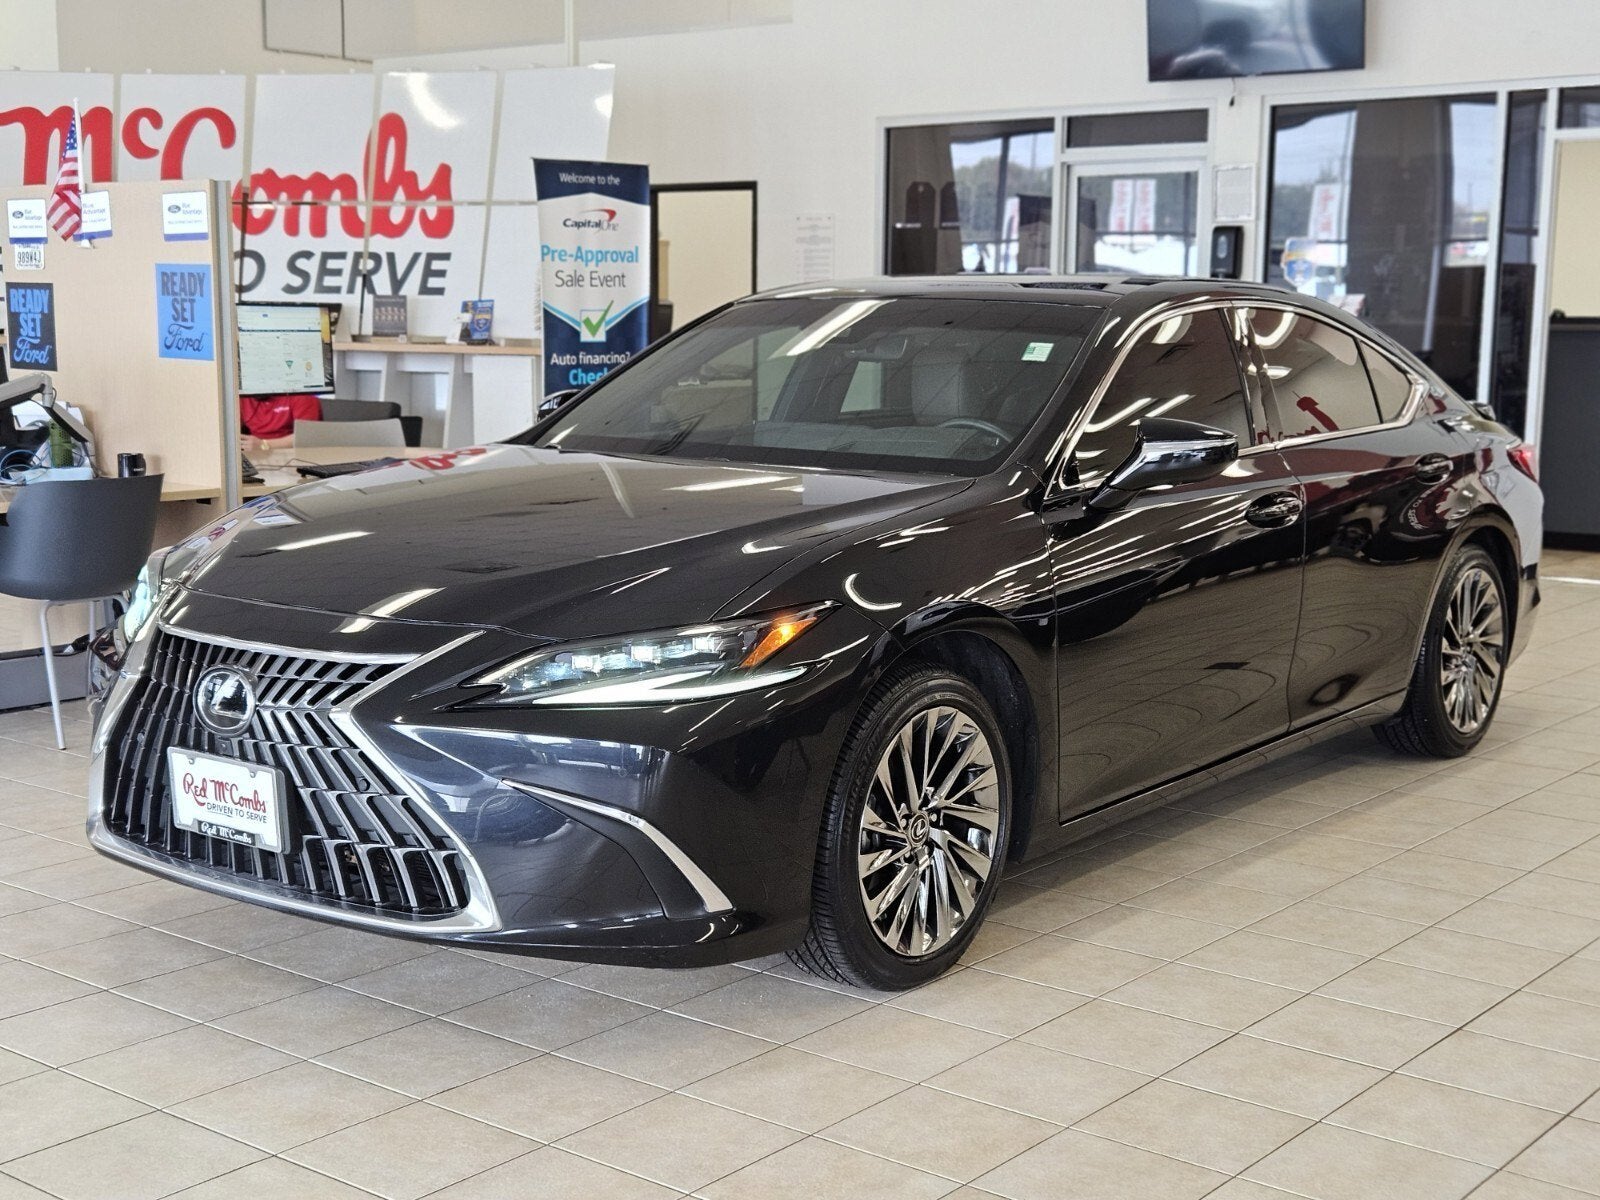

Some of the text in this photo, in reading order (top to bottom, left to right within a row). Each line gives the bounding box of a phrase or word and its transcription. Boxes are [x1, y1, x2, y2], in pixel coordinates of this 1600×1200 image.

[559, 172, 620, 186] Welcome to the
[541, 244, 639, 267] Pre-Approval
[160, 271, 206, 297] READY
[234, 250, 452, 296] O SERVE
[555, 269, 626, 288] Sale Event
[9, 288, 49, 313] READY
[171, 298, 196, 323] SET
[19, 313, 42, 337] SET
[164, 323, 205, 352] Ford
[14, 336, 50, 365] Ford
[550, 351, 631, 365] Auto financing?
[183, 772, 267, 813] Red McCombs
[206, 802, 268, 824] DRIVEN TO SERVE
[201, 821, 217, 836] Red
